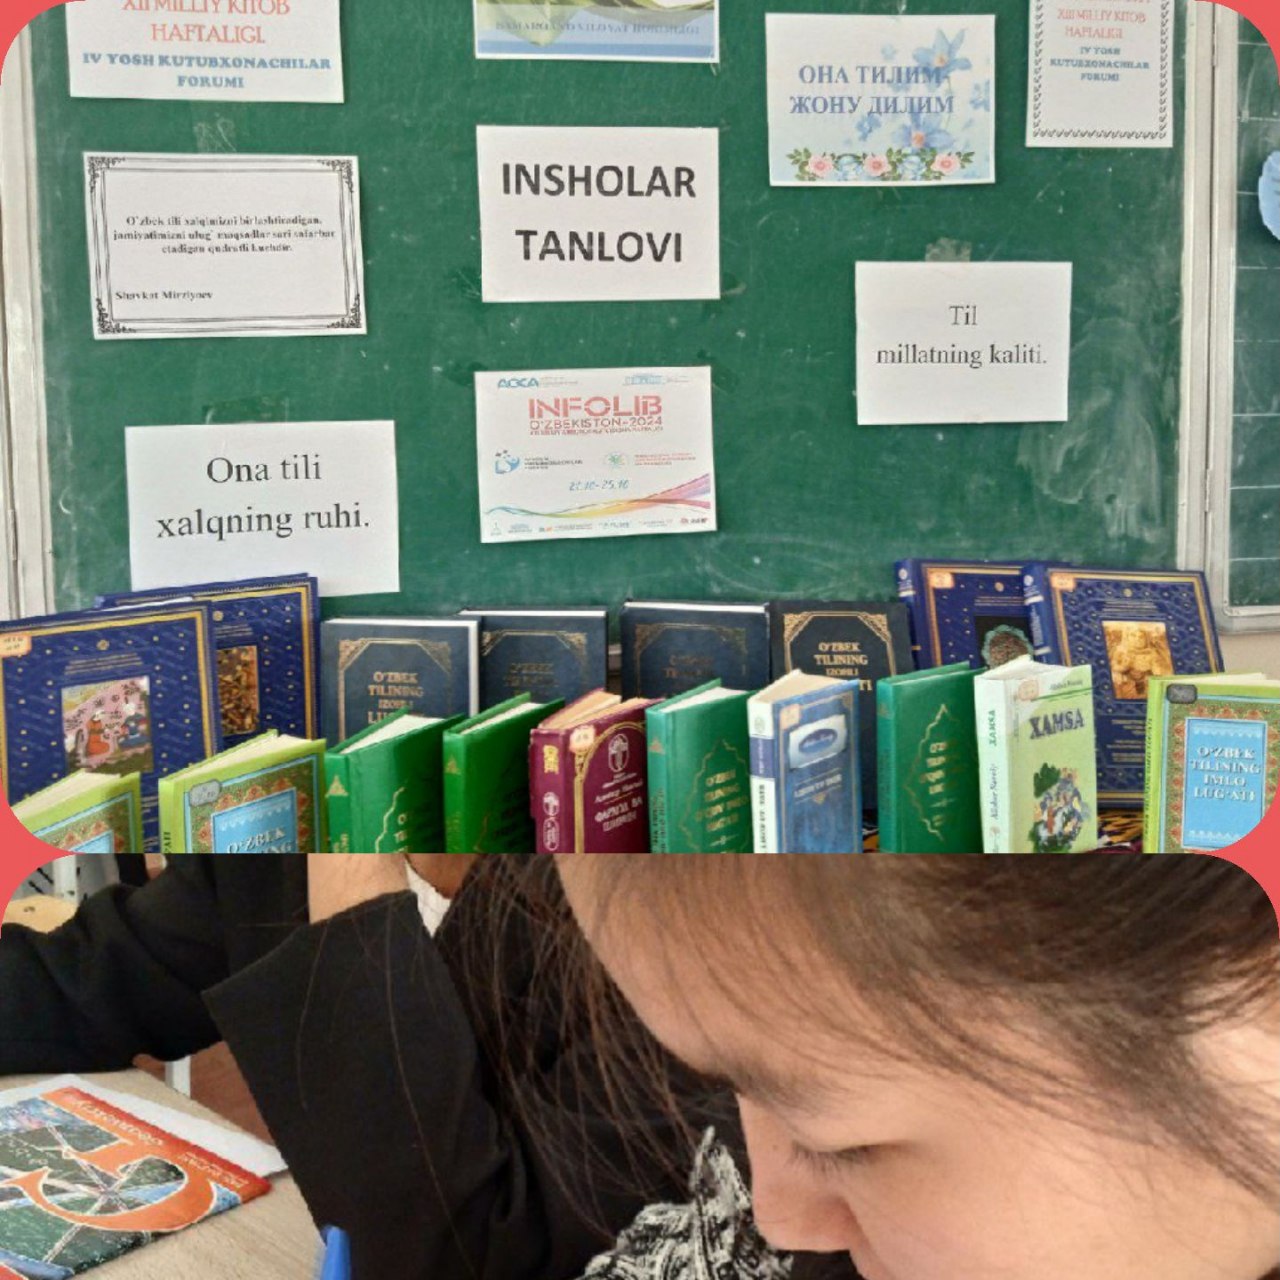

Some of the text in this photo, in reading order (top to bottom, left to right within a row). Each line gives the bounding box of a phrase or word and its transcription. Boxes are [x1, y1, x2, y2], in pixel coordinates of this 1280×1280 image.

[226, 0, 291, 15] KITOB
[82, 52, 332, 70] IV YOSH KUTUBXONACHILAR
[177, 74, 244, 88] FORUMI
[799, 64, 849, 84] ОНА
[789, 96, 954, 116] ЖОНУ ДИЛИМ
[502, 163, 696, 198] INSHOLAR
[515, 229, 682, 263] TANLOVI
[949, 304, 978, 326] Til
[876, 343, 1048, 369] millatning kaliti.
[528, 394, 663, 420] INFOLIB
[206, 454, 322, 483] Ona tili
[156, 501, 370, 542] xalqning ruhi.
[813, 654, 869, 666] TILINING
[988, 710, 997, 747] XAMSA
[1028, 708, 1085, 740] XAMSA
[1190, 760, 1261, 776] TILINING
[1203, 774, 1247, 788] IMLO
